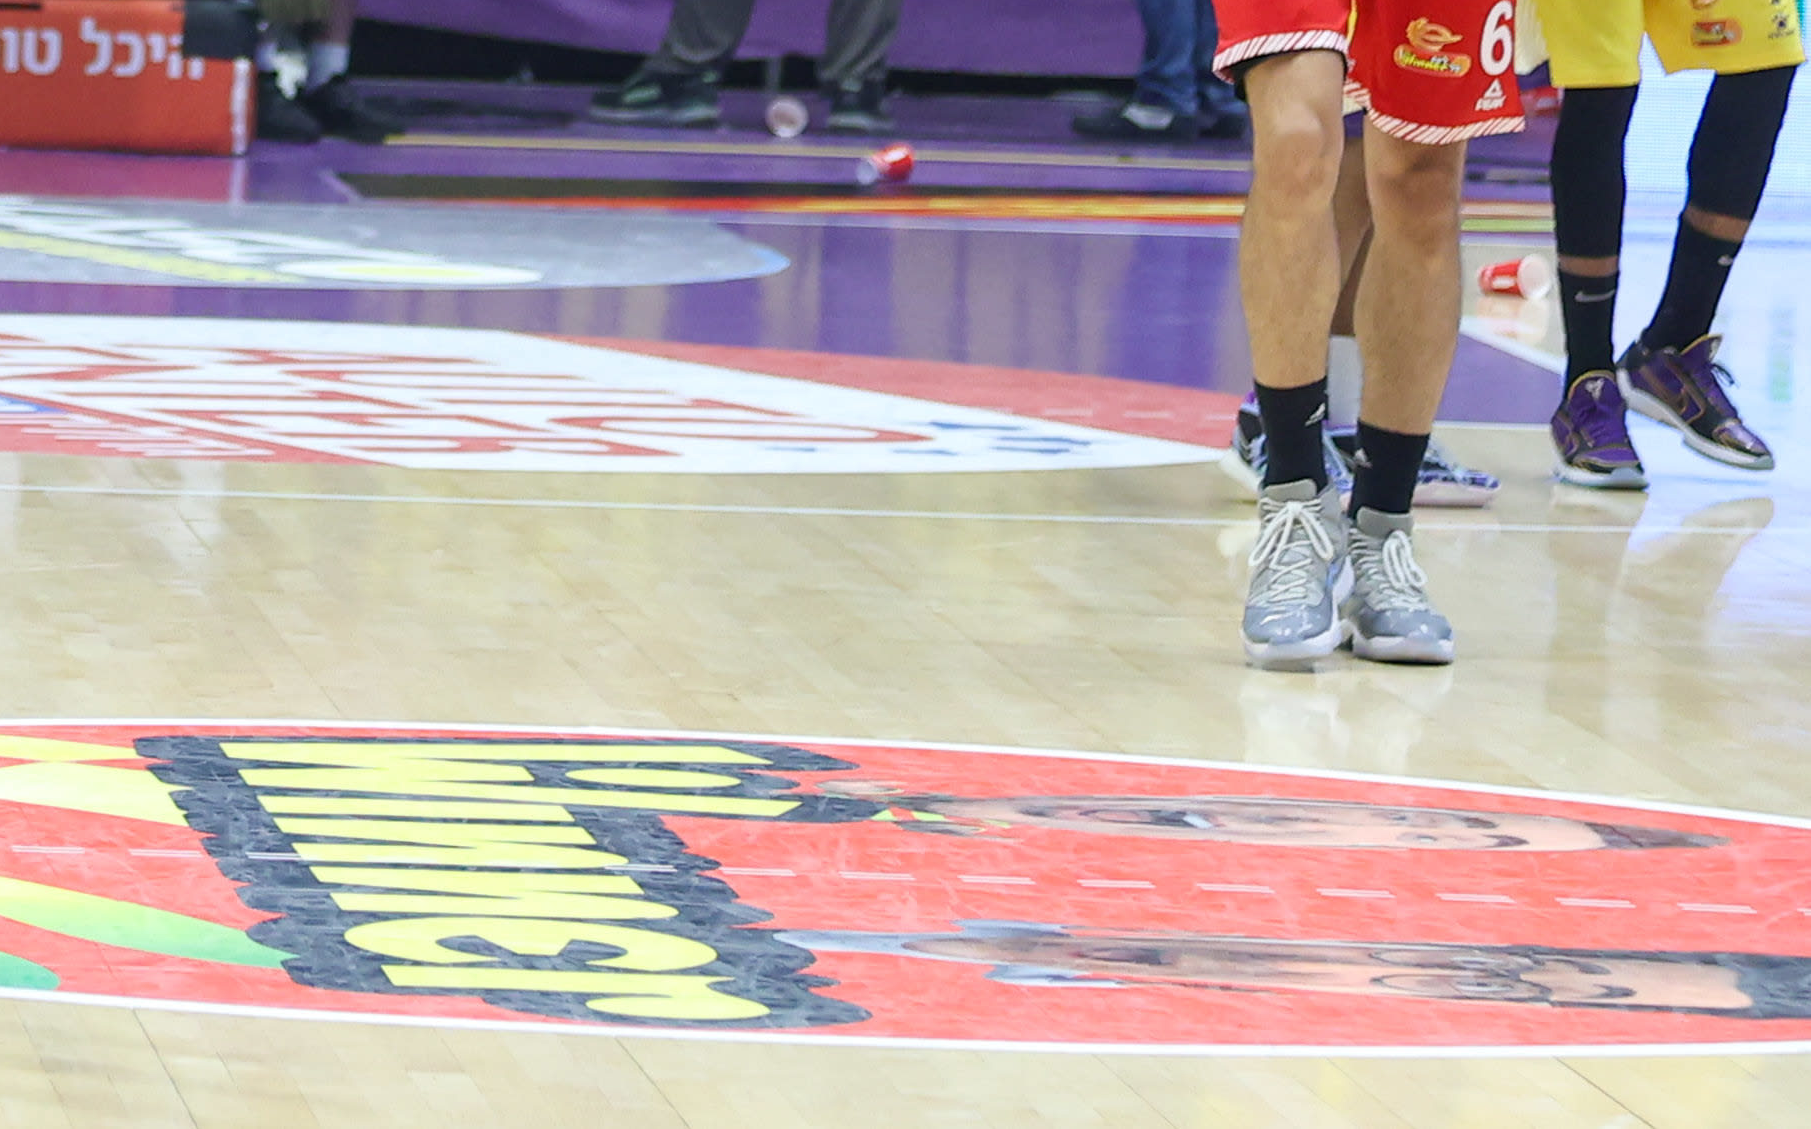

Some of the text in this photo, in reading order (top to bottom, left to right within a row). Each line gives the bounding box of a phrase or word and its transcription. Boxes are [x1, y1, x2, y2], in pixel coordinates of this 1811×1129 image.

[1480, 0, 1513, 76] 6
[107, 343, 932, 443] AUTO
[219, 739, 803, 1021] Winner
